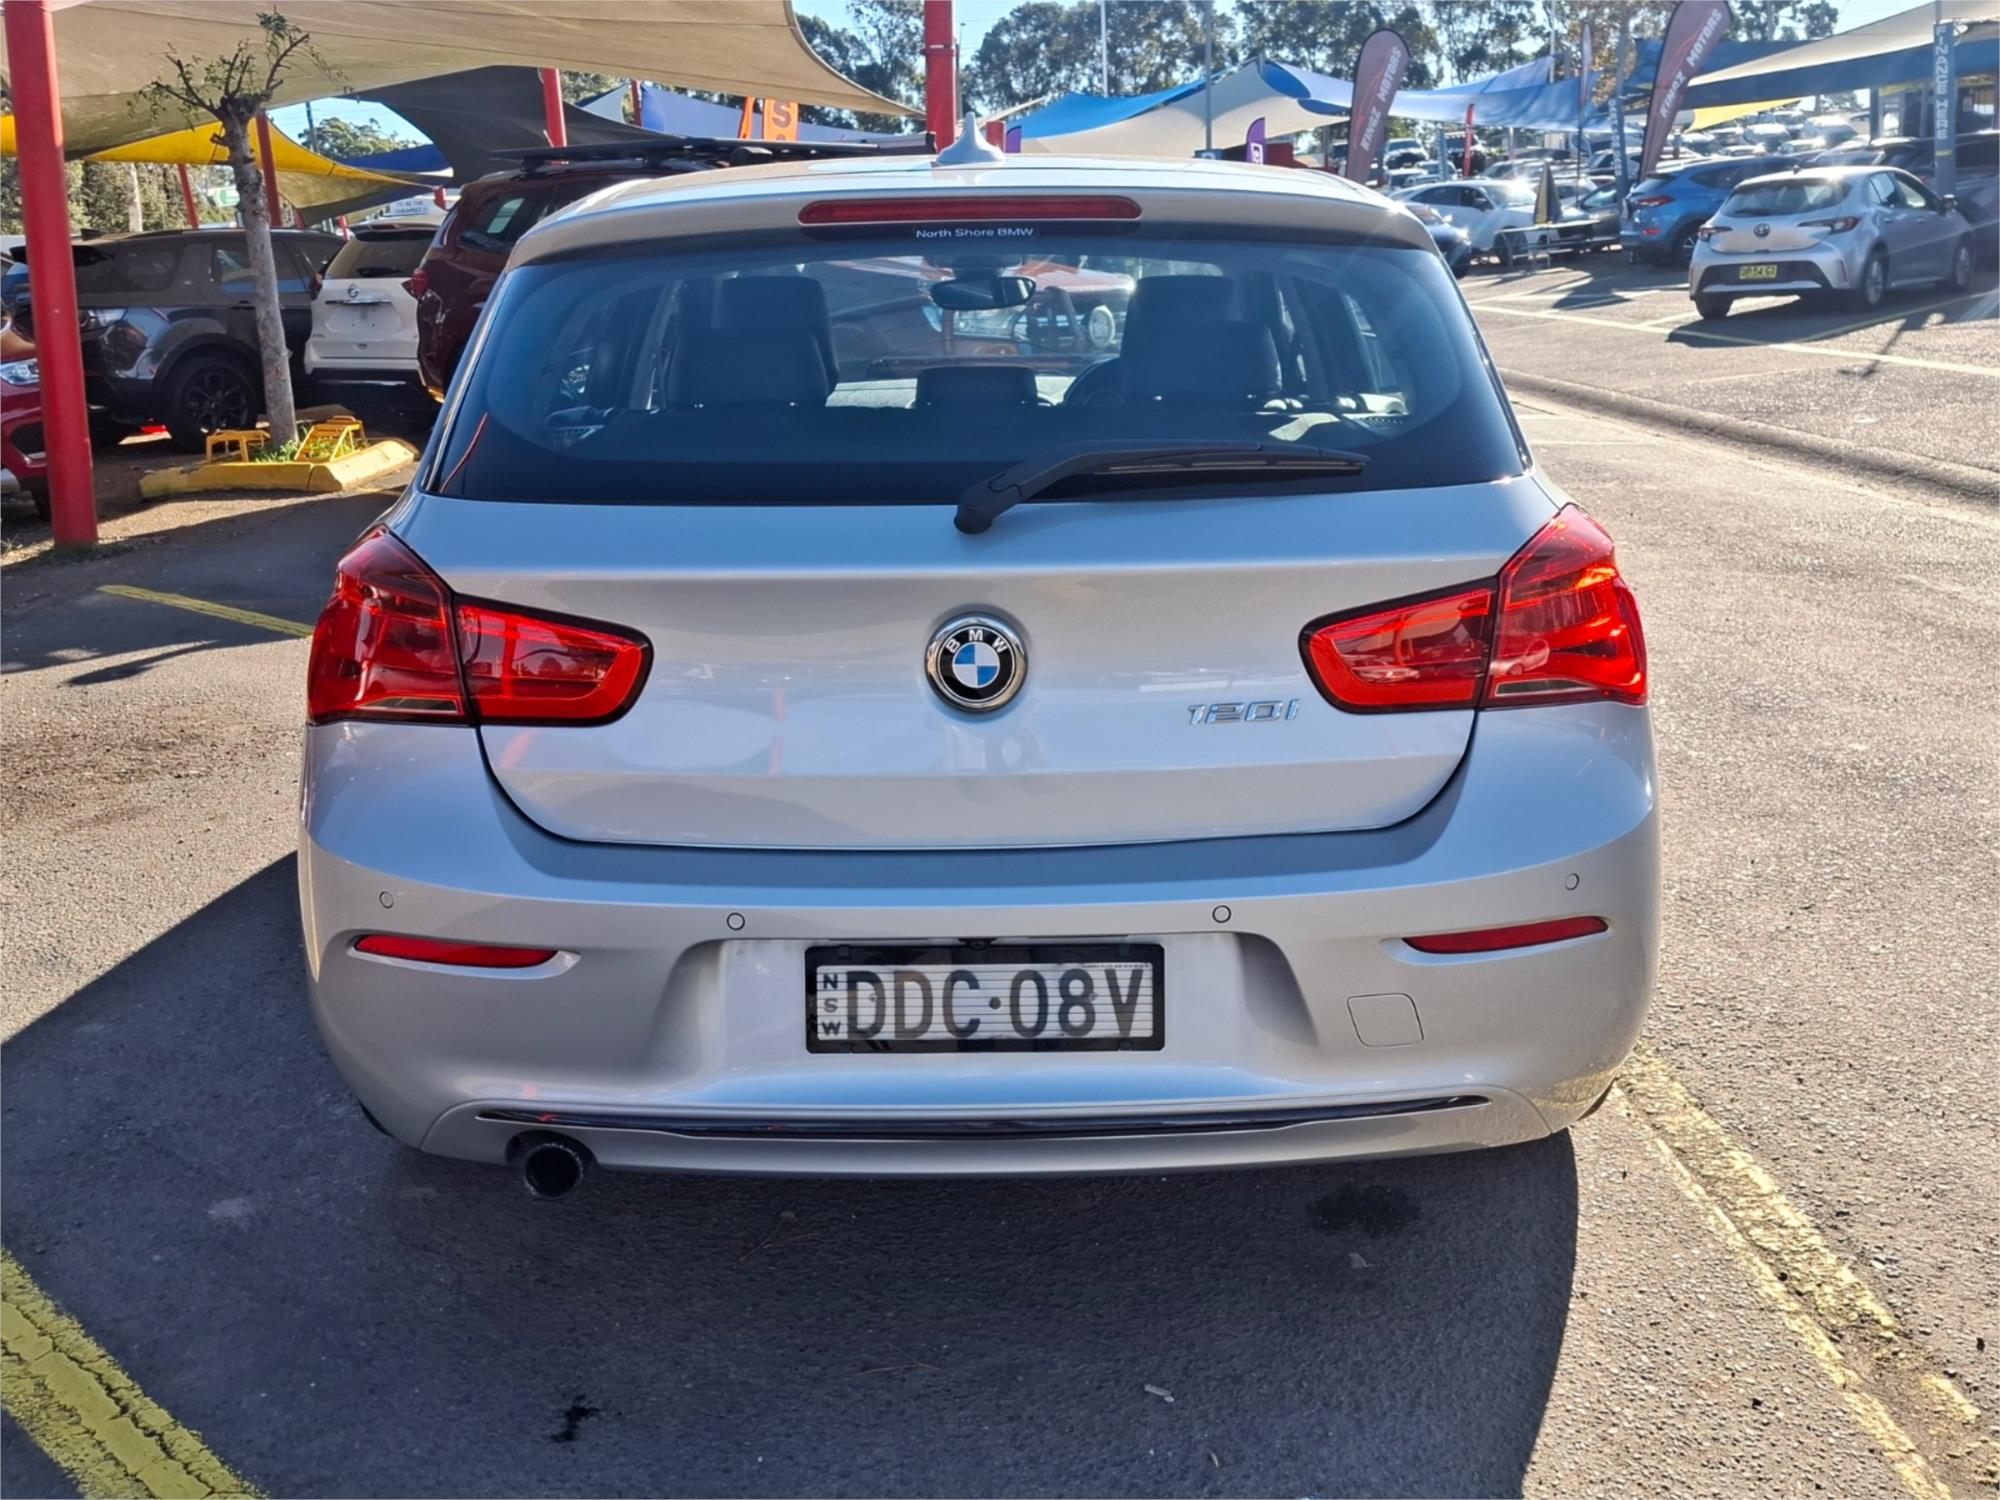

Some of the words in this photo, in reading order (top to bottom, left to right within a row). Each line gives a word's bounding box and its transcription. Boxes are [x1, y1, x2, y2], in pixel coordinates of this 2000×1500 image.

[1686, 8, 1723, 67] MOTORS
[1935, 25, 1948, 95] FINANCE
[1377, 46, 1402, 102] MOTORS
[1935, 100, 1948, 140] HERE
[916, 229, 952, 238] North
[955, 228, 994, 237] Shore
[997, 227, 1034, 236] BMW
[945, 629, 1008, 654] BMW
[1188, 699, 1300, 725] 120i
[821, 972, 842, 1036] NSW
